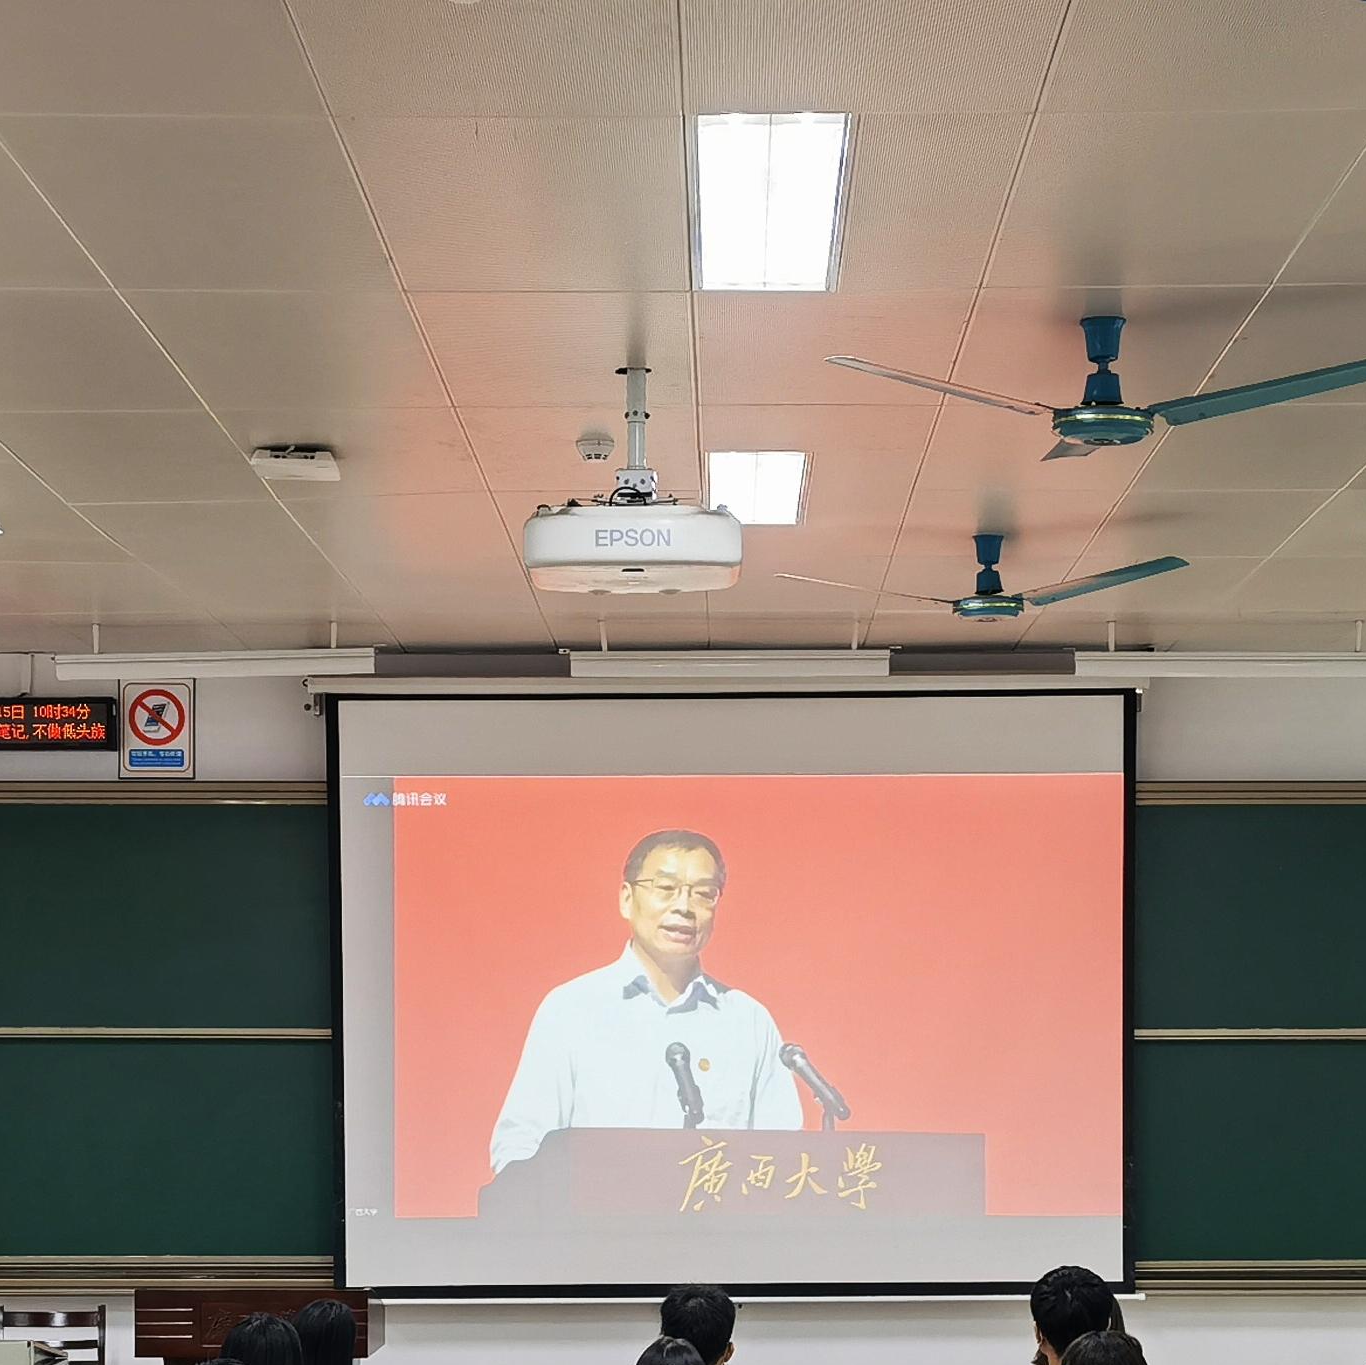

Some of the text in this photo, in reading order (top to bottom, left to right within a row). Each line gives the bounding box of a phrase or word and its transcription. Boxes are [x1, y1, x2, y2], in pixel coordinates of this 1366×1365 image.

[595, 528, 671, 547] EPSON
[33, 704, 91, 720] 10时34分
[392, 792, 447, 806] 腾讯会议
